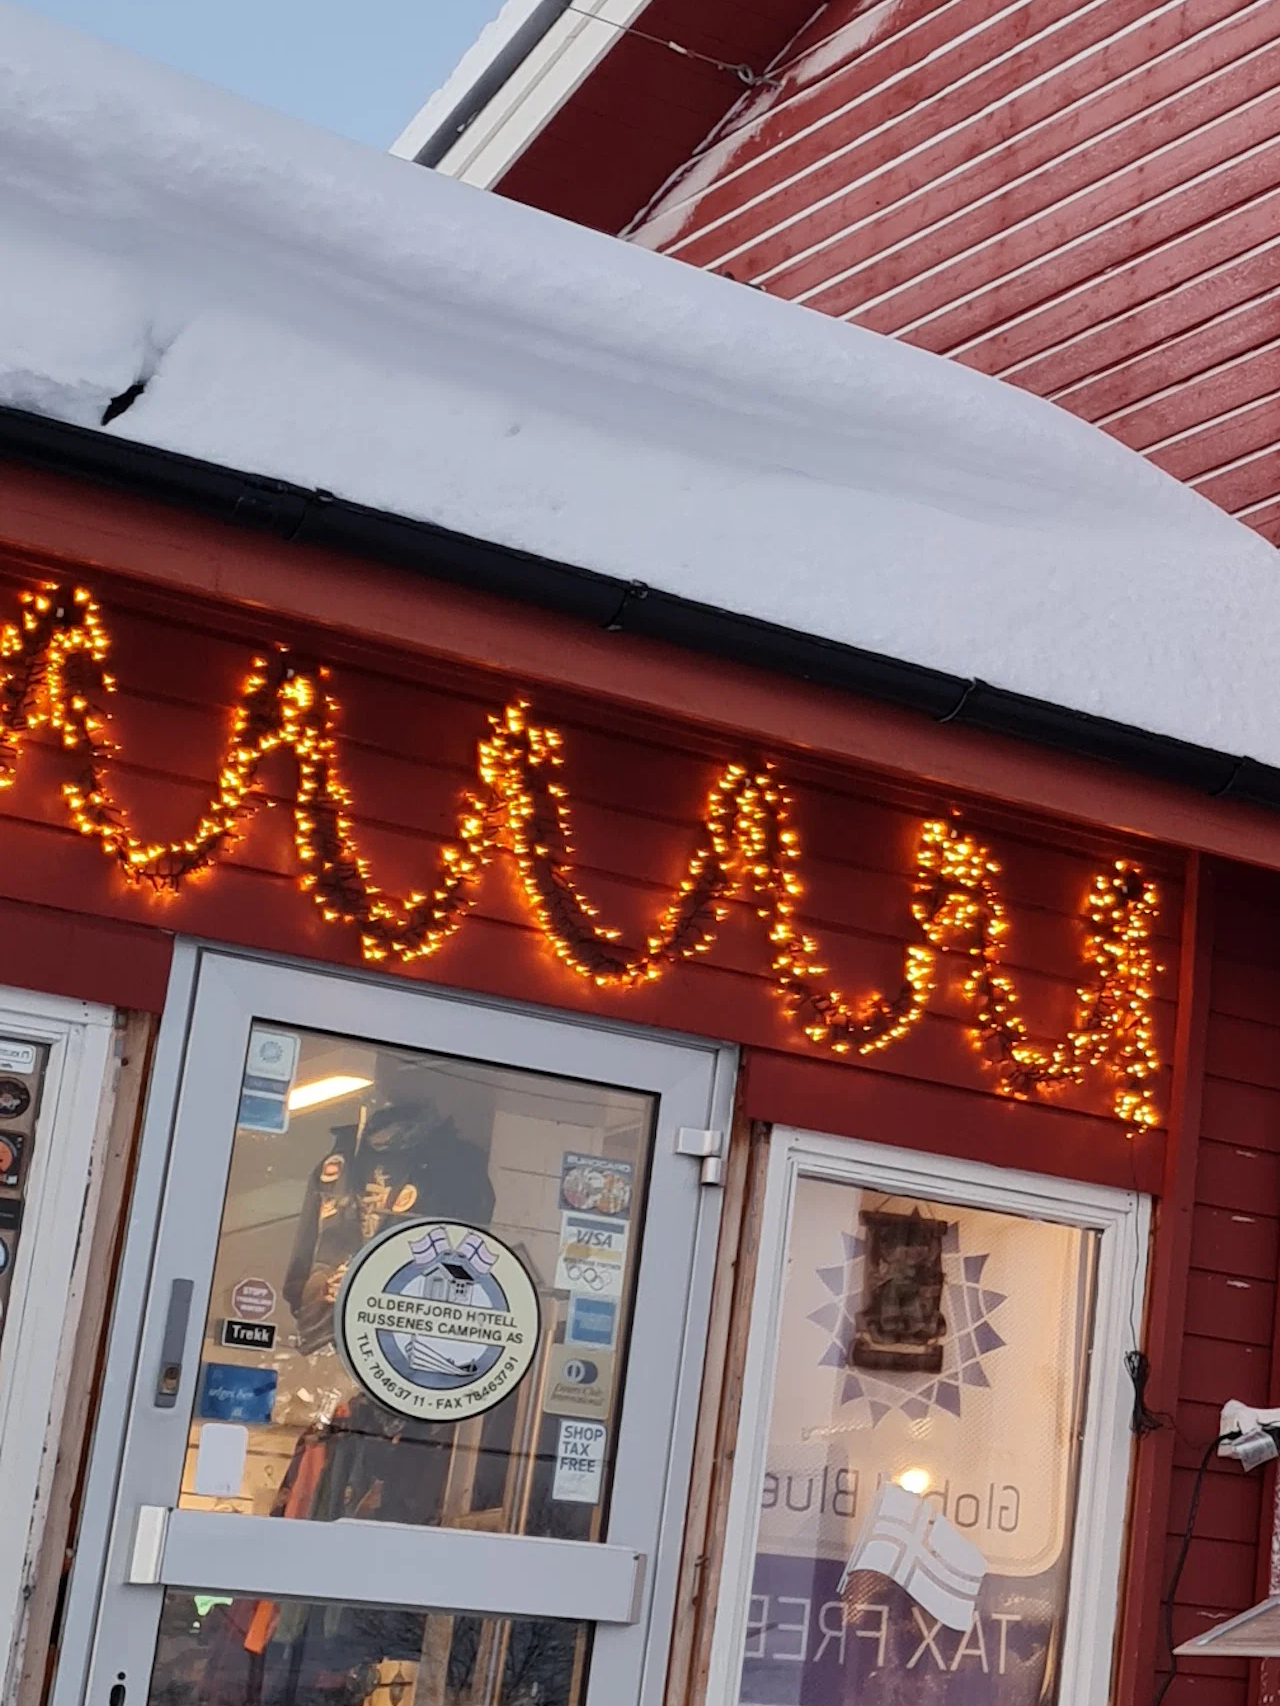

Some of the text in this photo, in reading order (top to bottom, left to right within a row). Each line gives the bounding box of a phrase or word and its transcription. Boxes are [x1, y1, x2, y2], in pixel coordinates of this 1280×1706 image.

[575, 1229, 613, 1248] VISA
[366, 1296, 518, 1328] OLDERFJORD HOTELL
[232, 1325, 269, 1342] Trekk
[357, 1311, 523, 1344] RUSSENES CAMPING AS
[436, 1398, 463, 1410] FAX
[563, 1425, 604, 1442] SHOP
[562, 1442, 592, 1457] TAX
[559, 1457, 596, 1473] FREE
